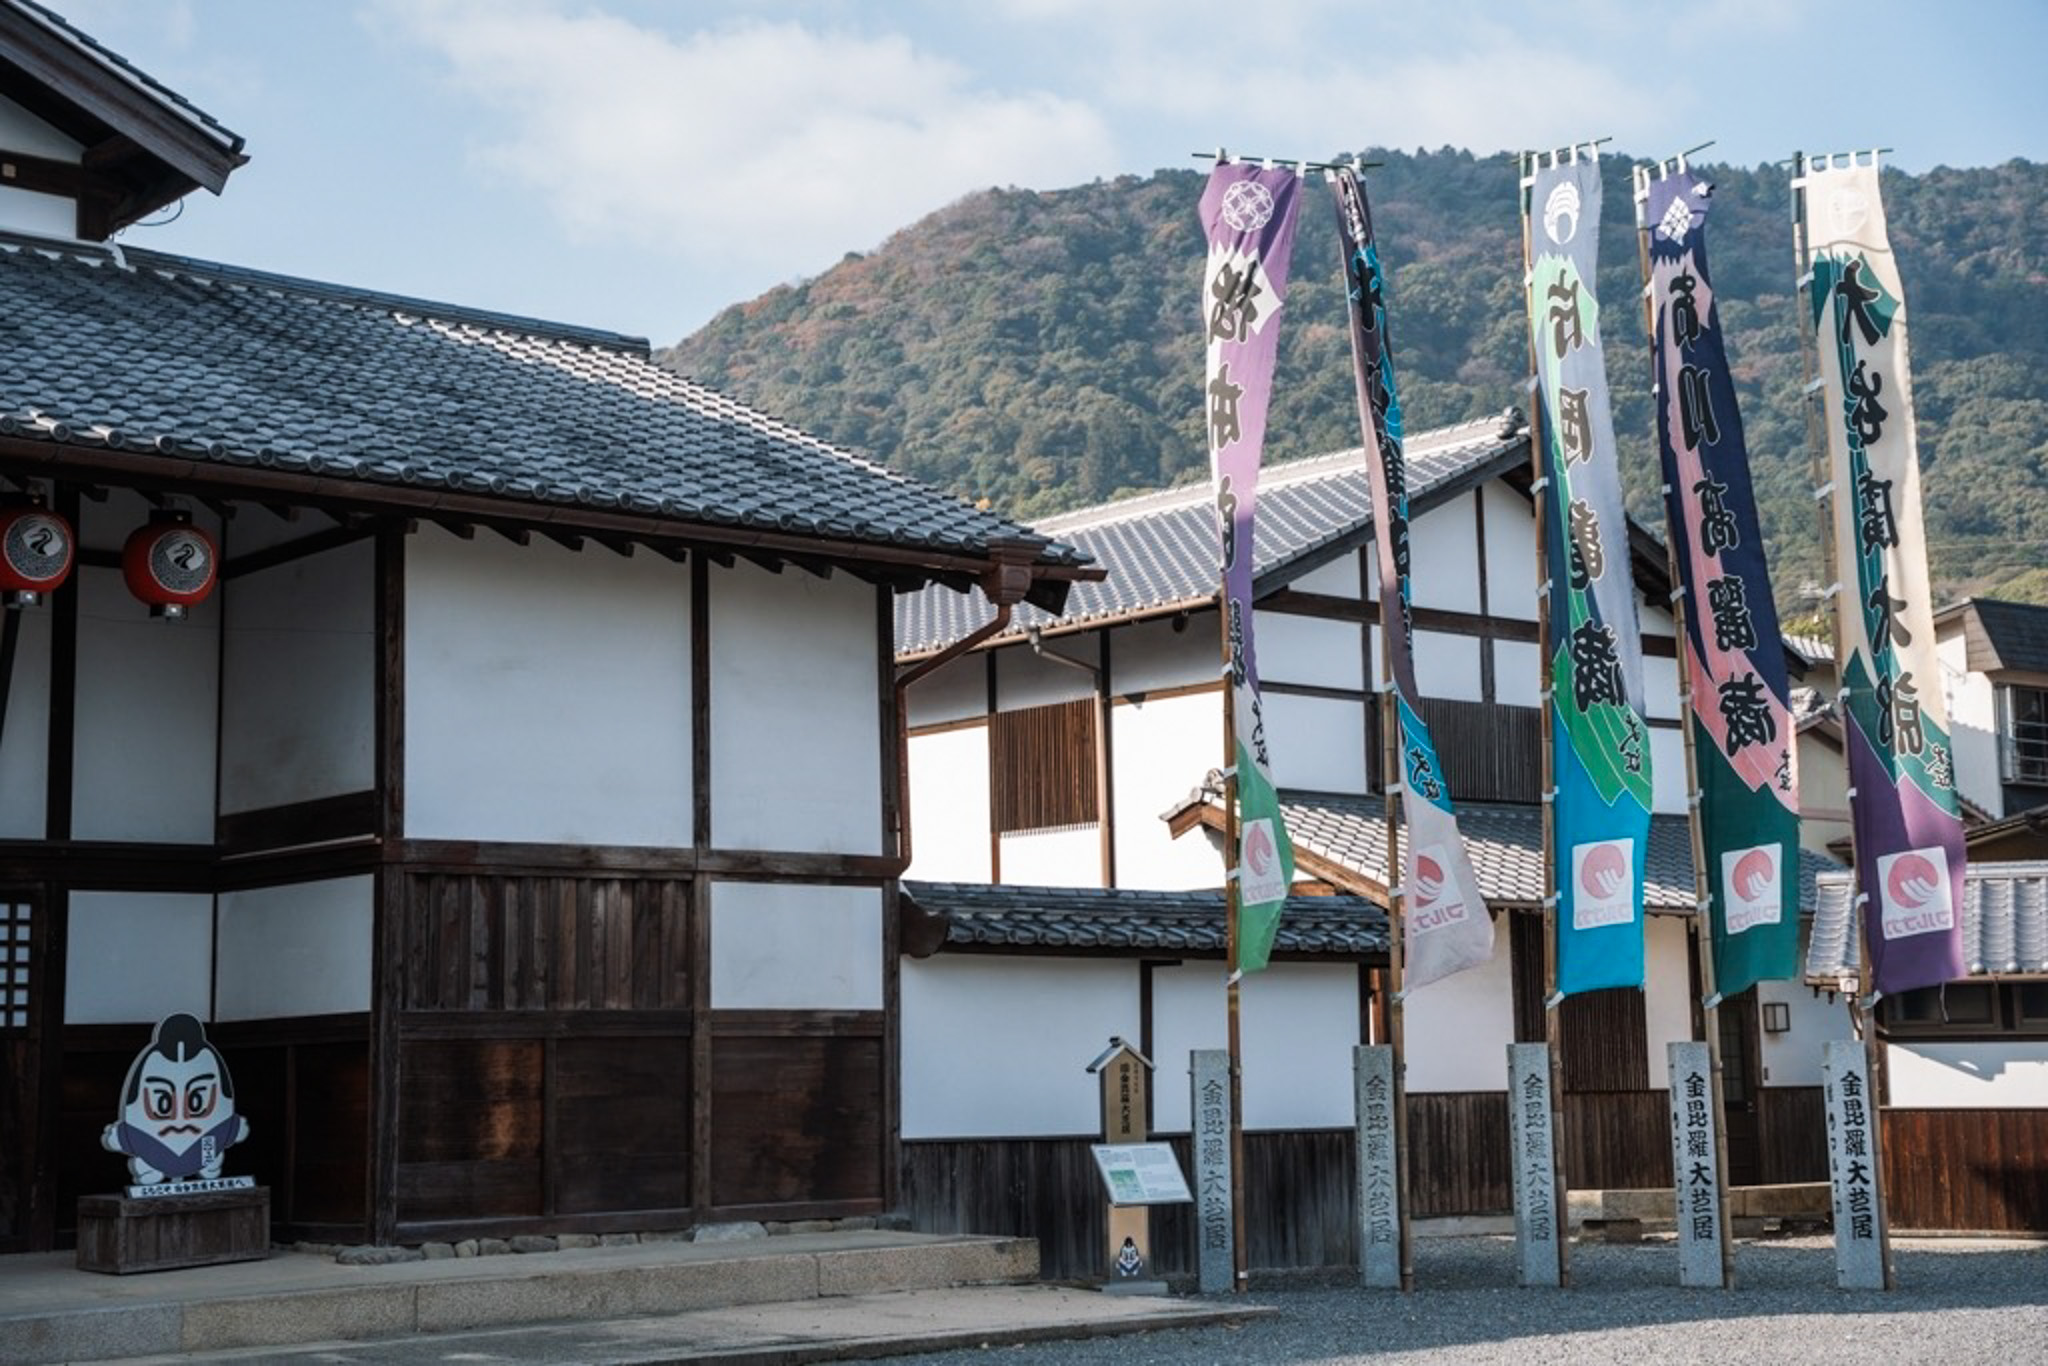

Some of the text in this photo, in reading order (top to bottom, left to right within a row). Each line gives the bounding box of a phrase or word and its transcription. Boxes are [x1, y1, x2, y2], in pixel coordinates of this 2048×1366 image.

[1684, 1071, 1713, 1242] 金毘羅大芝居
[1840, 1070, 1873, 1241] 金毘羅大芝居
